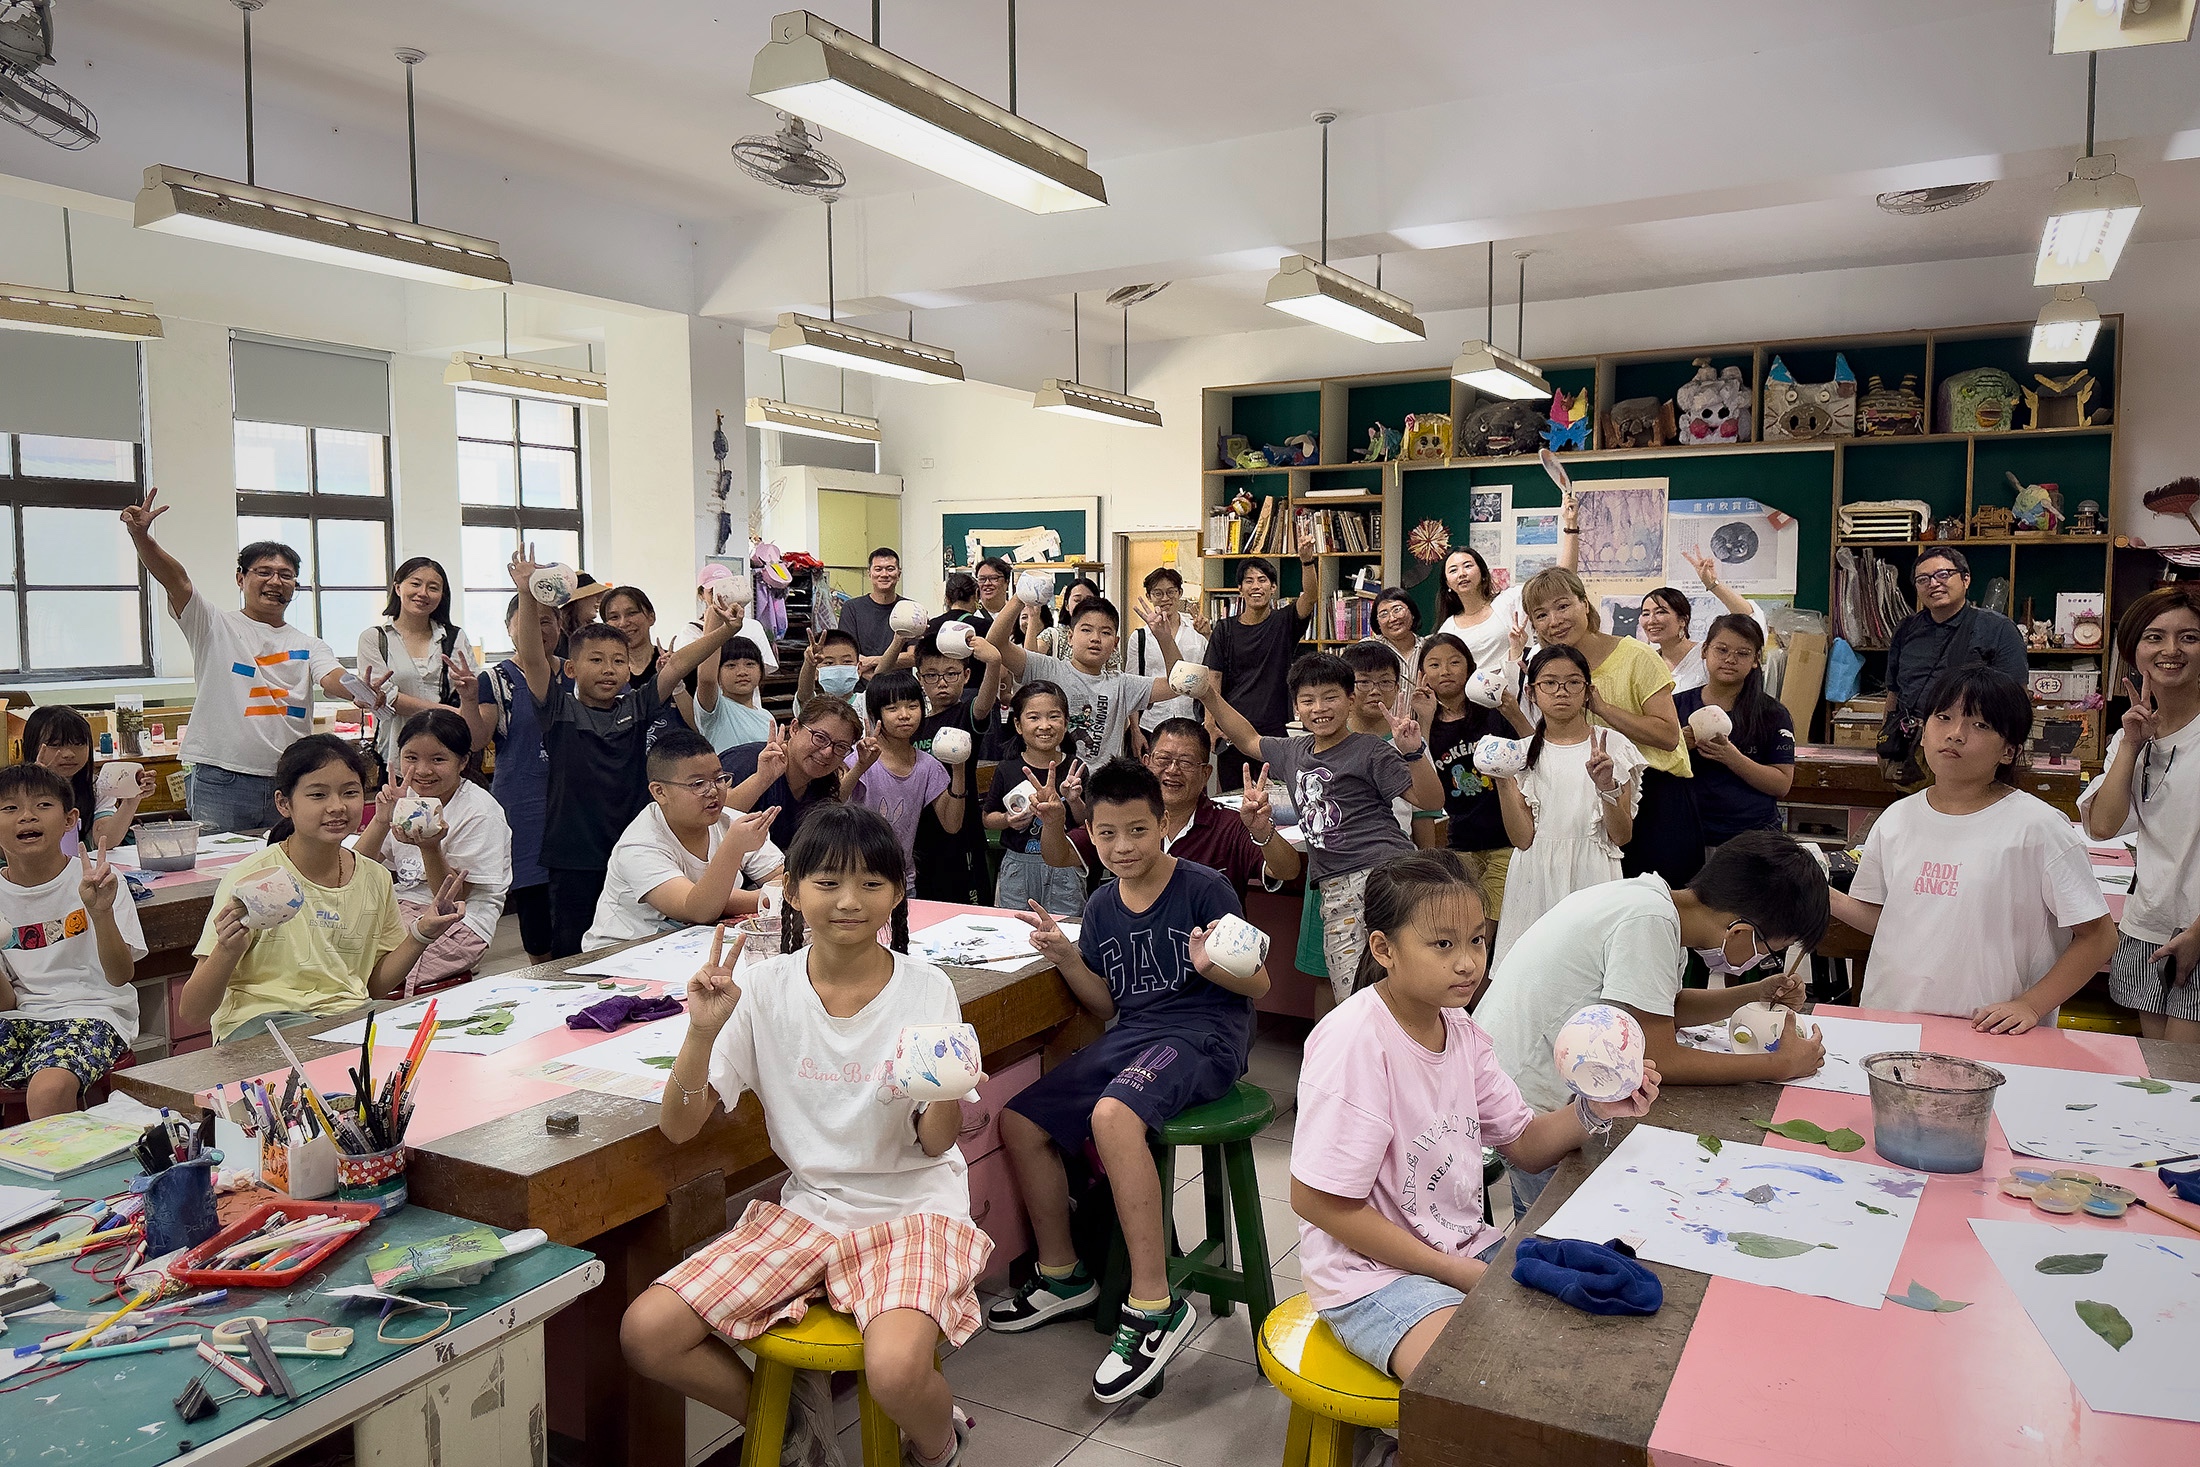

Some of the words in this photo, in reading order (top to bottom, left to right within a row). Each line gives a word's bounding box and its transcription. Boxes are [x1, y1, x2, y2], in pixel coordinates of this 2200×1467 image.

[2039, 681, 2060, 690] 杯子
[1921, 861, 1959, 881] RADI
[1913, 876, 1959, 897] ANCE
[316, 910, 340, 921] FILA
